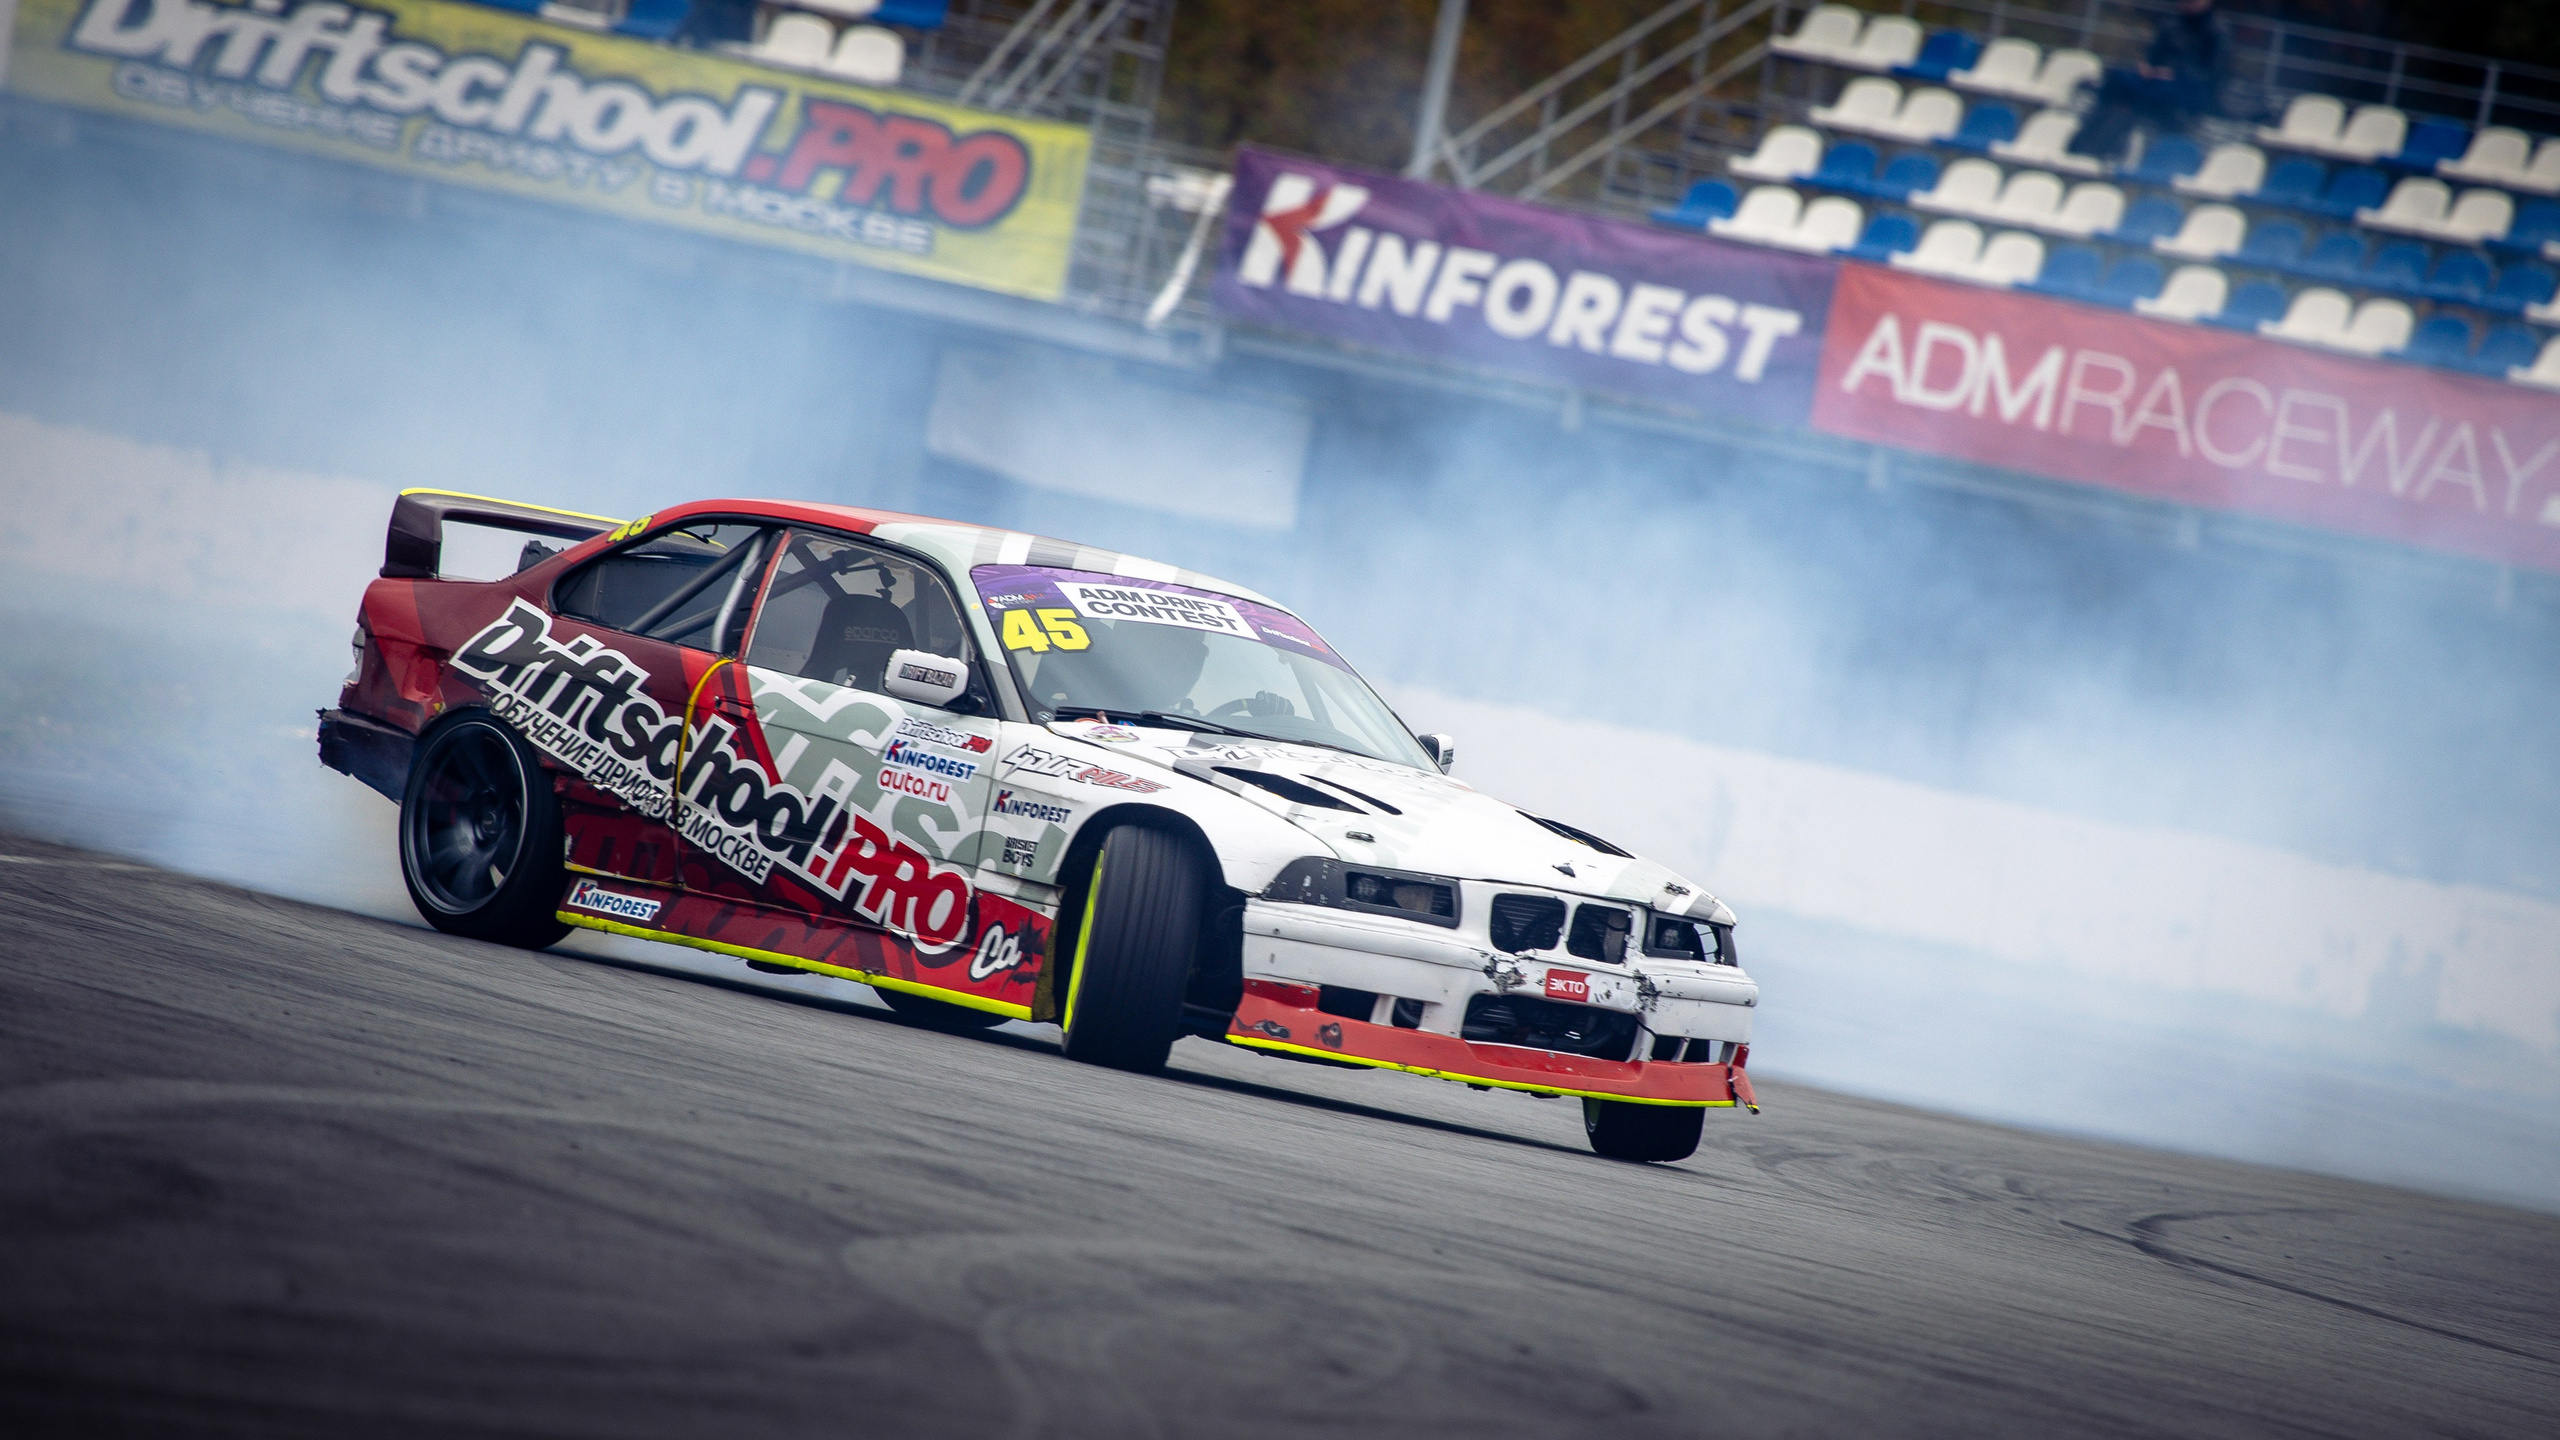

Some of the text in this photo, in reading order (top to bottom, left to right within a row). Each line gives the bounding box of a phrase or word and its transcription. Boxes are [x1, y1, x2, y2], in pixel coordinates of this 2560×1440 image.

[71, 0, 1028, 228] Driftschool.PRO
[706, 183, 933, 255] МОСКВЕ
[1237, 172, 1801, 384] KINFOREST
[1079, 588, 1226, 616] ADM DRIFT
[1087, 601, 1239, 631] CONTEST
[1002, 608, 1091, 653] 45
[452, 599, 970, 951] Driftschool.PRO
[885, 738, 977, 780] KINFOREST
[494, 692, 600, 769] ОБУЧЕНИЕ
[676, 803, 692, 828] В
[686, 818, 774, 881] МОСКВЕ
[879, 769, 950, 803] auto.ru
[992, 789, 1072, 824] KINFOREST
[1002, 849, 1035, 868] BOYS
[573, 881, 660, 918] KINFOREST
